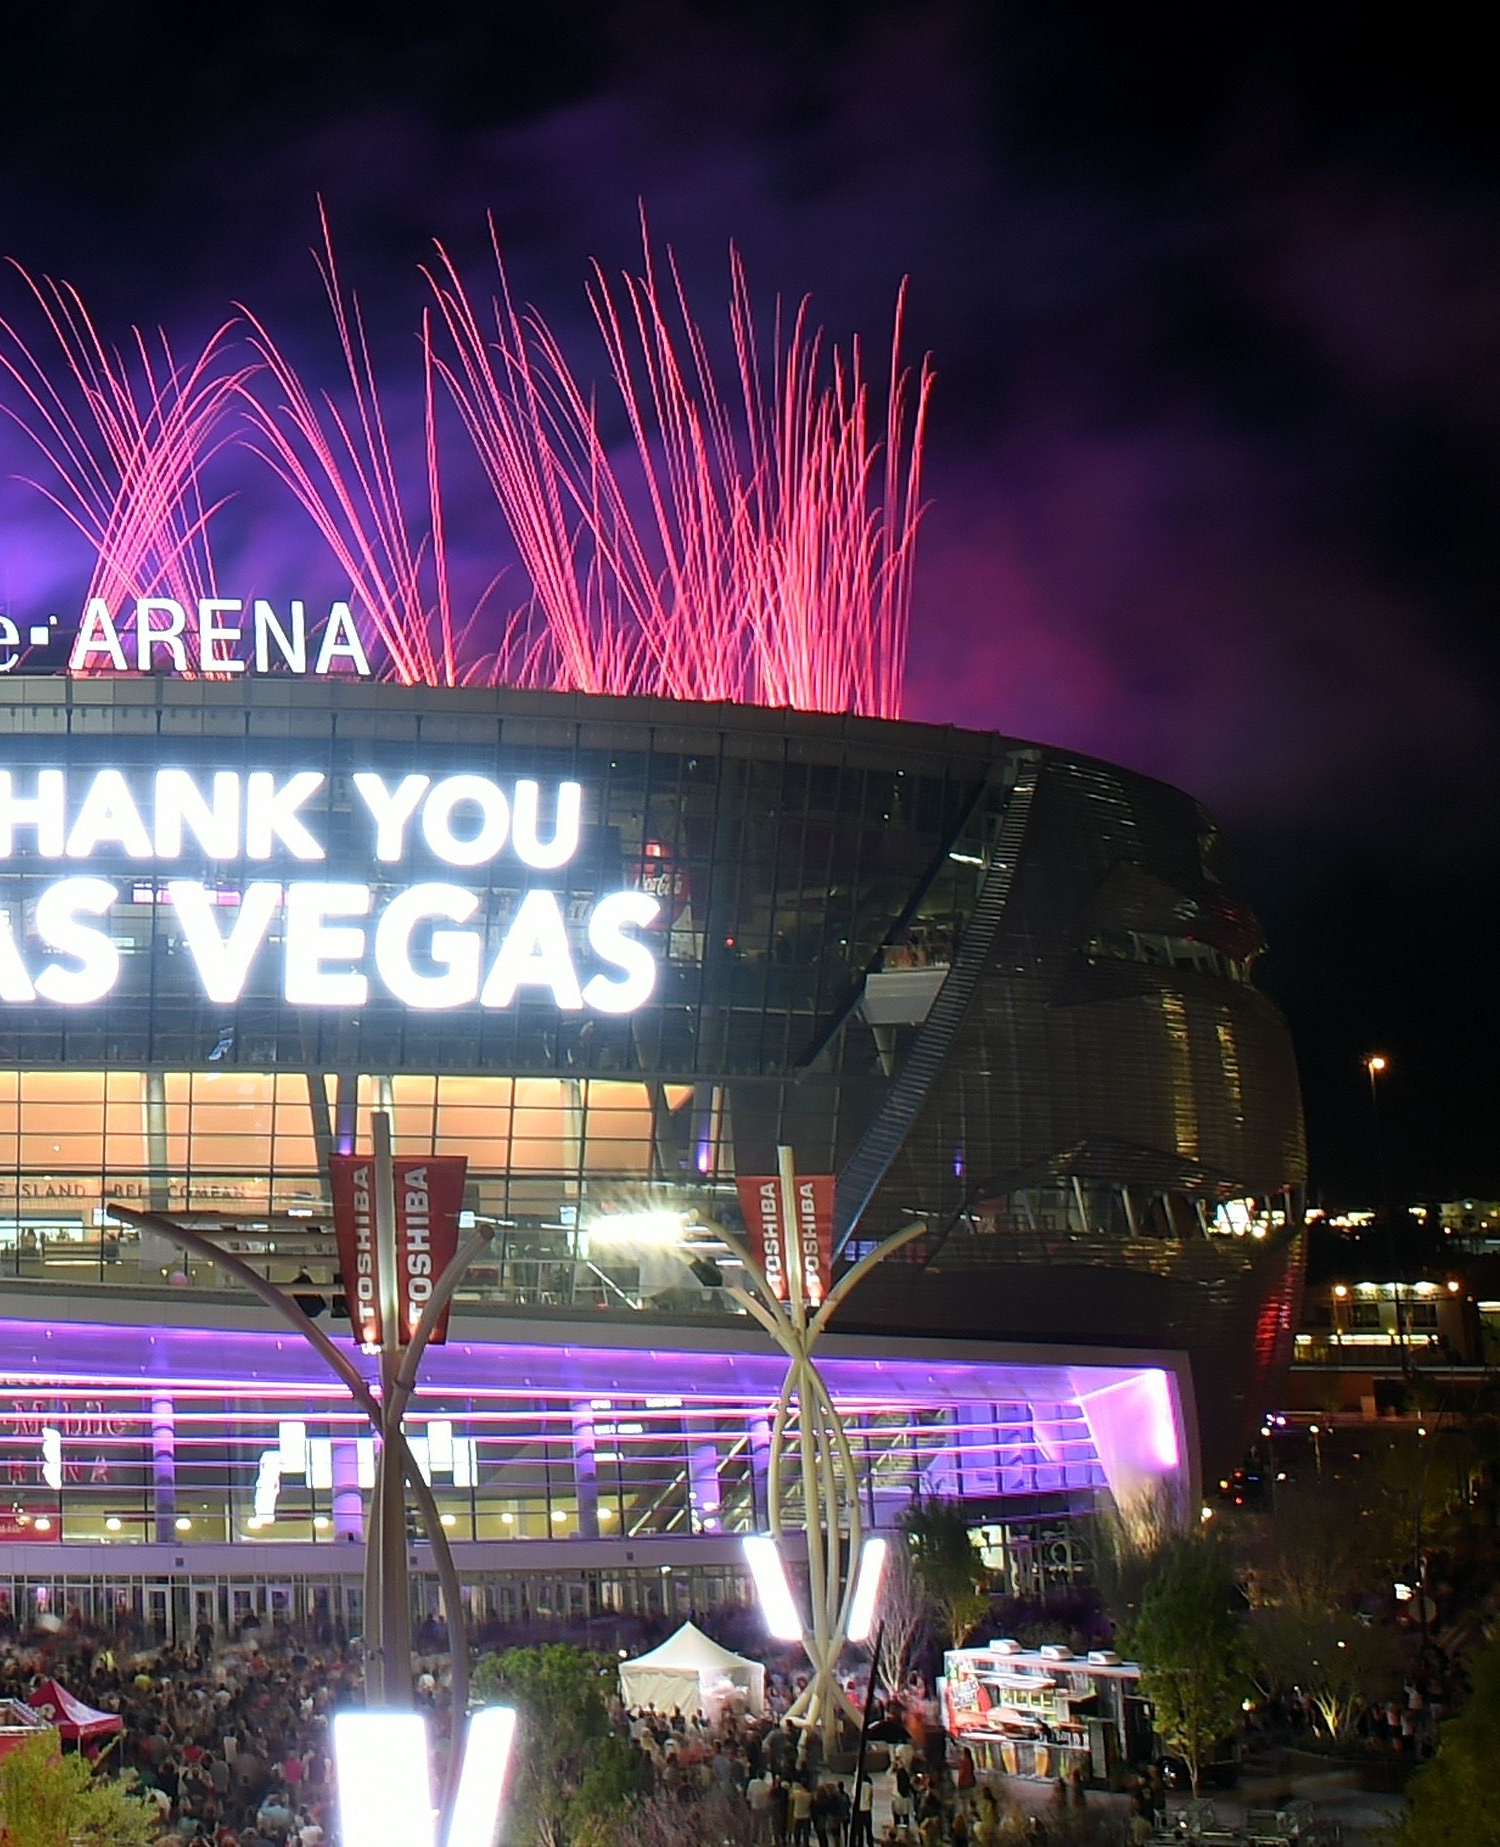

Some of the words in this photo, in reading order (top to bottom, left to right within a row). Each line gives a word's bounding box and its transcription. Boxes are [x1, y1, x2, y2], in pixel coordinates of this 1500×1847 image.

[70, 597, 372, 676] ARENA
[352, 772, 582, 870] YOU
[167, 881, 661, 1014] VEGAS
[353, 1166, 376, 1324] TOSHIBA
[404, 1166, 434, 1326] TOSHIBA
